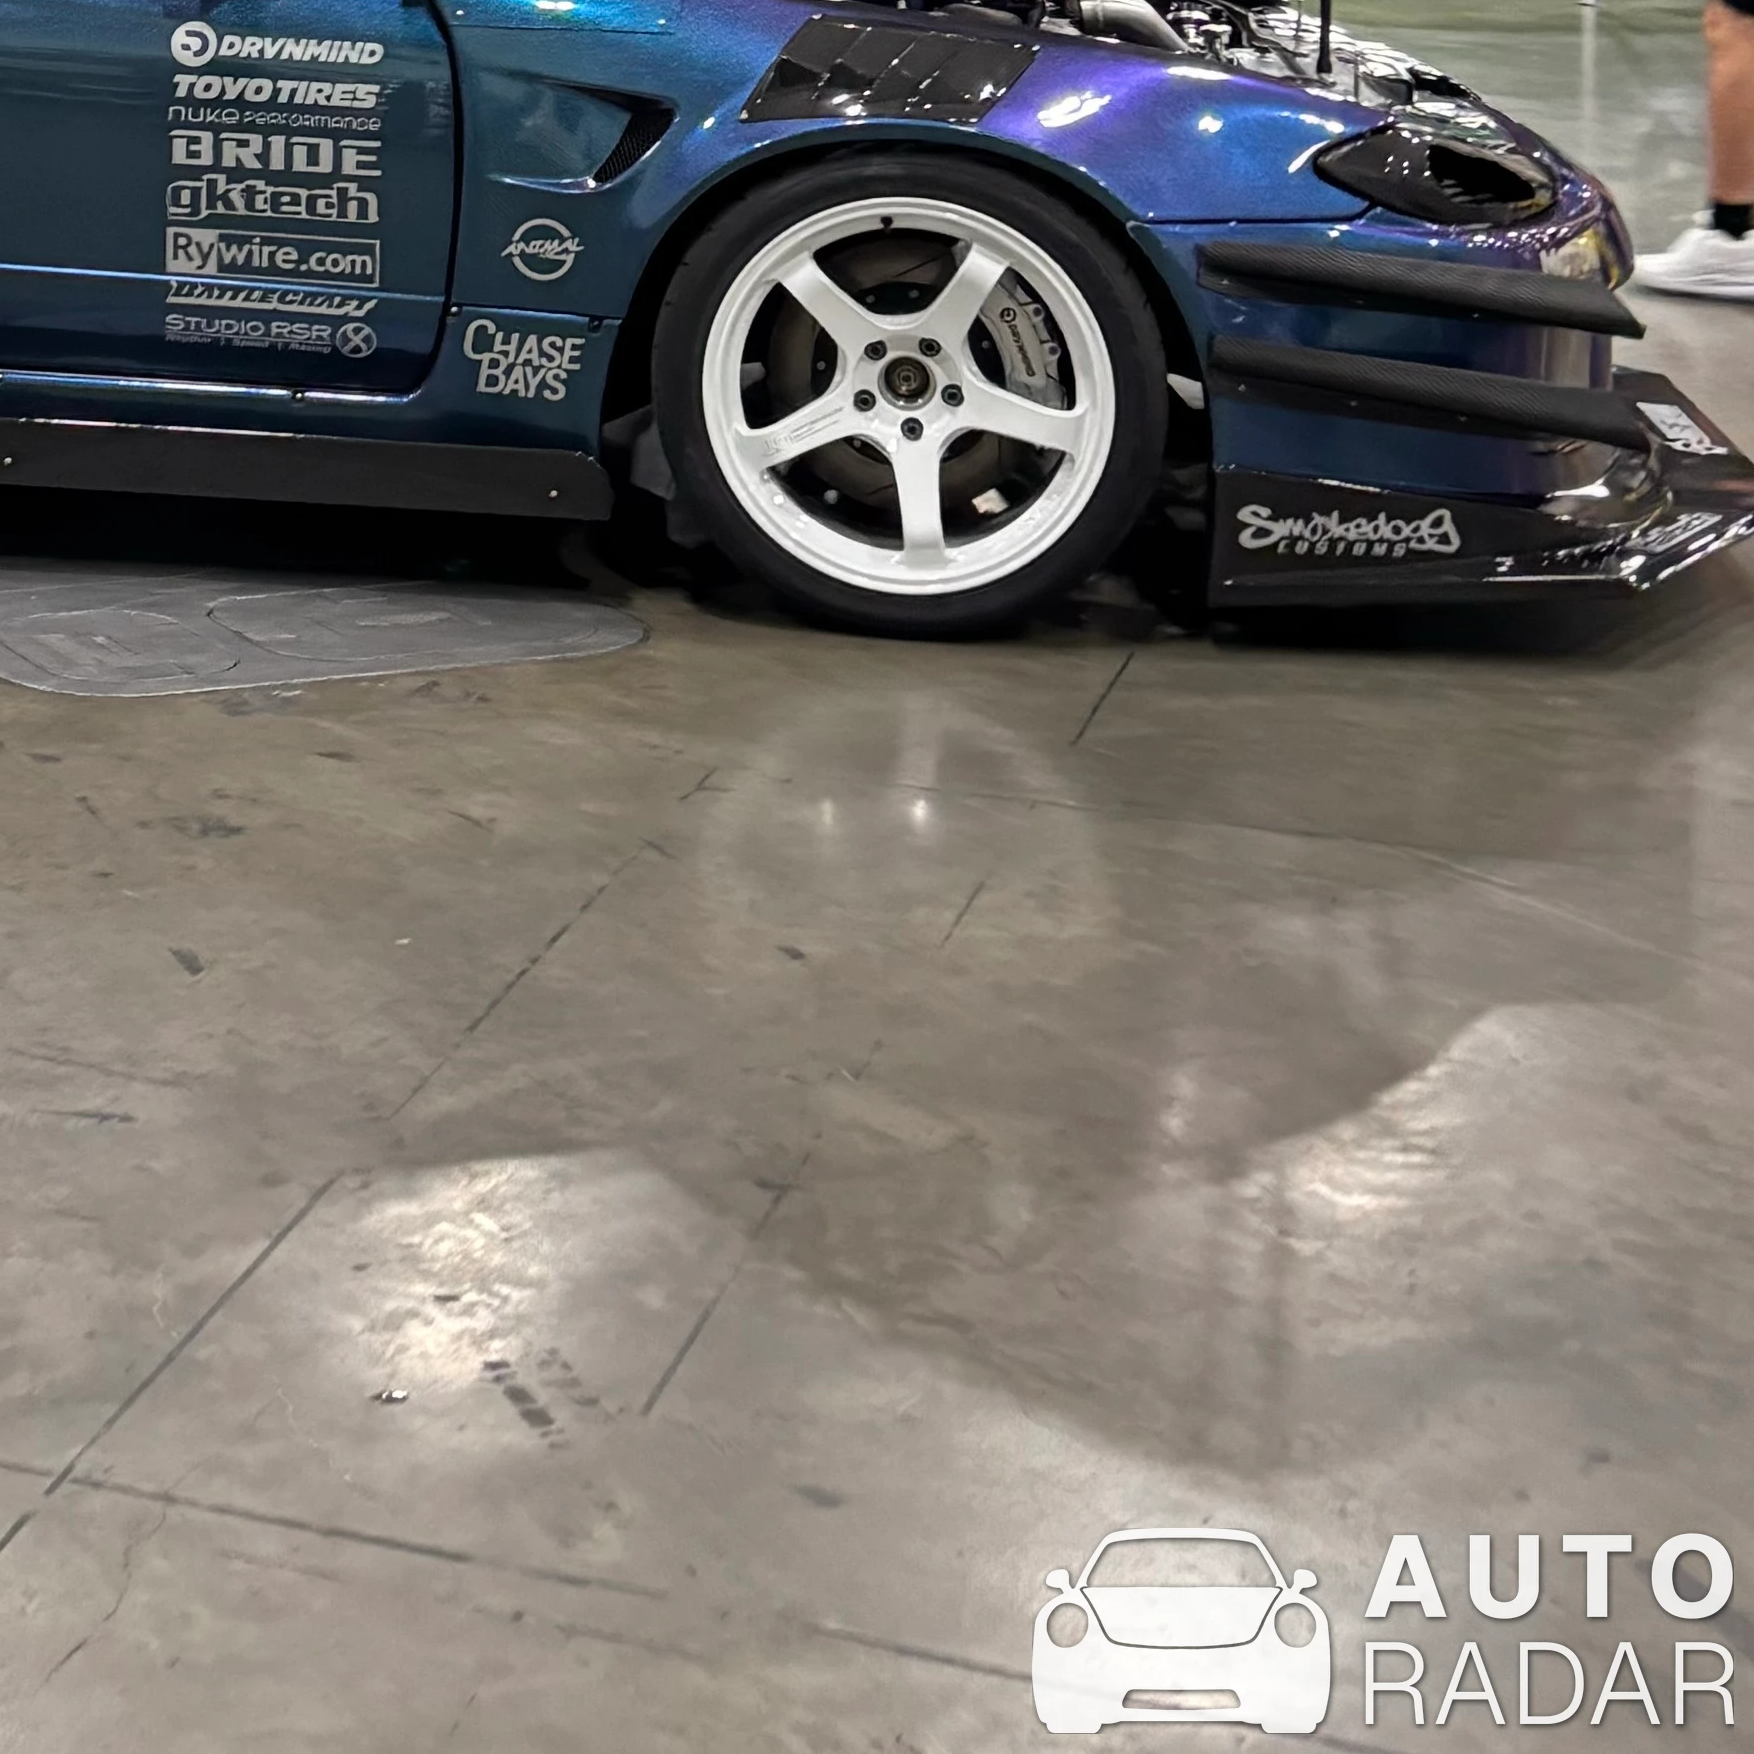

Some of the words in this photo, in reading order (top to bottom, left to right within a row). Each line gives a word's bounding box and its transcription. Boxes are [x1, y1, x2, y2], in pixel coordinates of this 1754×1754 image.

[218, 35, 384, 64] DRVNMIND
[173, 74, 274, 103] TOYO
[274, 80, 380, 109] TIRES
[168, 129, 382, 176] BRIDE
[166, 173, 379, 223] gktech
[172, 231, 373, 276] Rywire.com
[165, 313, 265, 337] STUDIO
[270, 322, 332, 342] RSR
[476, 352, 568, 401] BAYS
